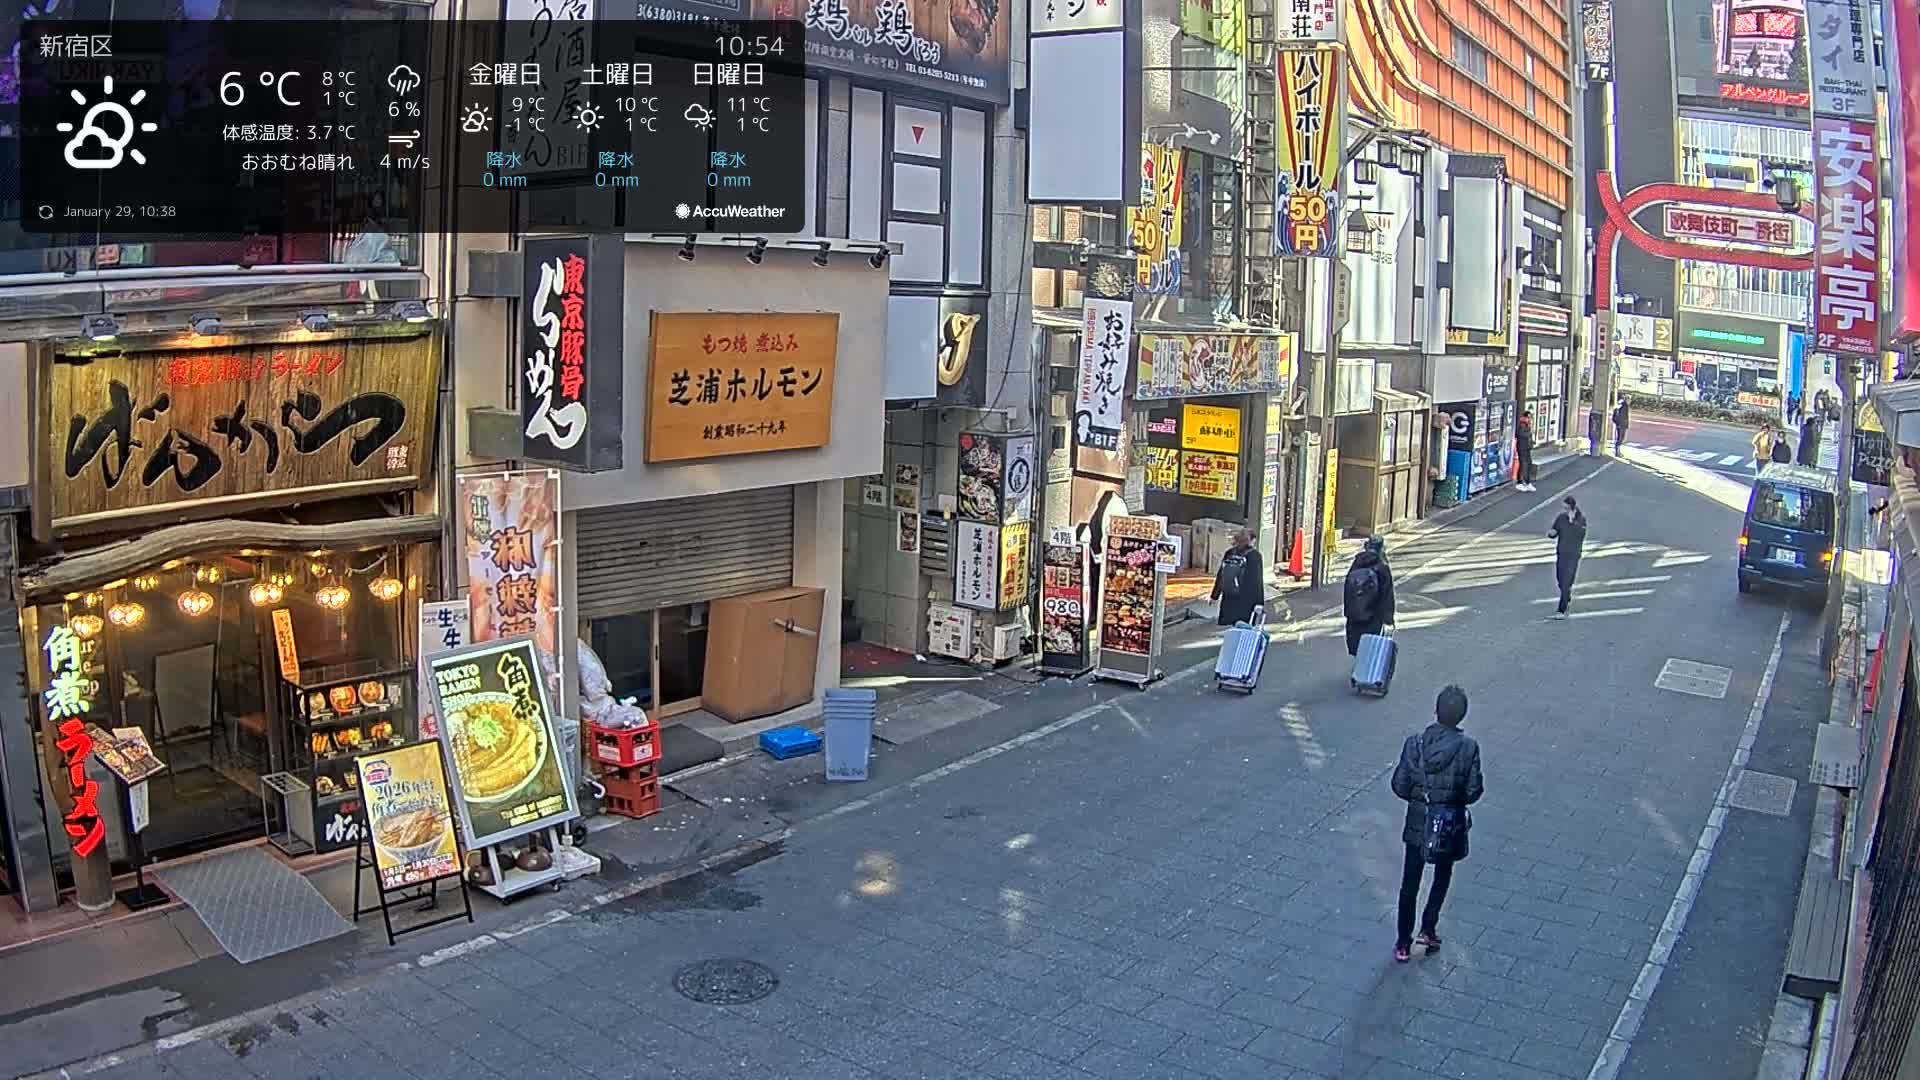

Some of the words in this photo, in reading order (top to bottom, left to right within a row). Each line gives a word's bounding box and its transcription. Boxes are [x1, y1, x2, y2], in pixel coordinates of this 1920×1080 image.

[1588, 64, 1609, 80] 7F
[1831, 97, 1856, 111] 3F
[1296, 55, 1321, 191] ハイボール
[1669, 211, 1791, 243] 歌舞伎町一番街
[1819, 126, 1875, 330] 安楽亭
[560, 253, 586, 402] 東京豚骨
[1818, 333, 1837, 347] 2F
[701, 333, 748, 356] もつ焼
[755, 332, 801, 353] 煮込み
[1093, 309, 1126, 415] お好み焼き
[667, 366, 823, 407] 芝浦ホルモン
[702, 420, 788, 440] 創業昭和二十九年
[971, 527, 984, 600] 芝浦ホルモン
[1044, 598, 1081, 618] 980
[434, 663, 480, 684] TOKYO
[438, 676, 481, 697] RAMEN
[499, 655, 539, 720] 角煮
